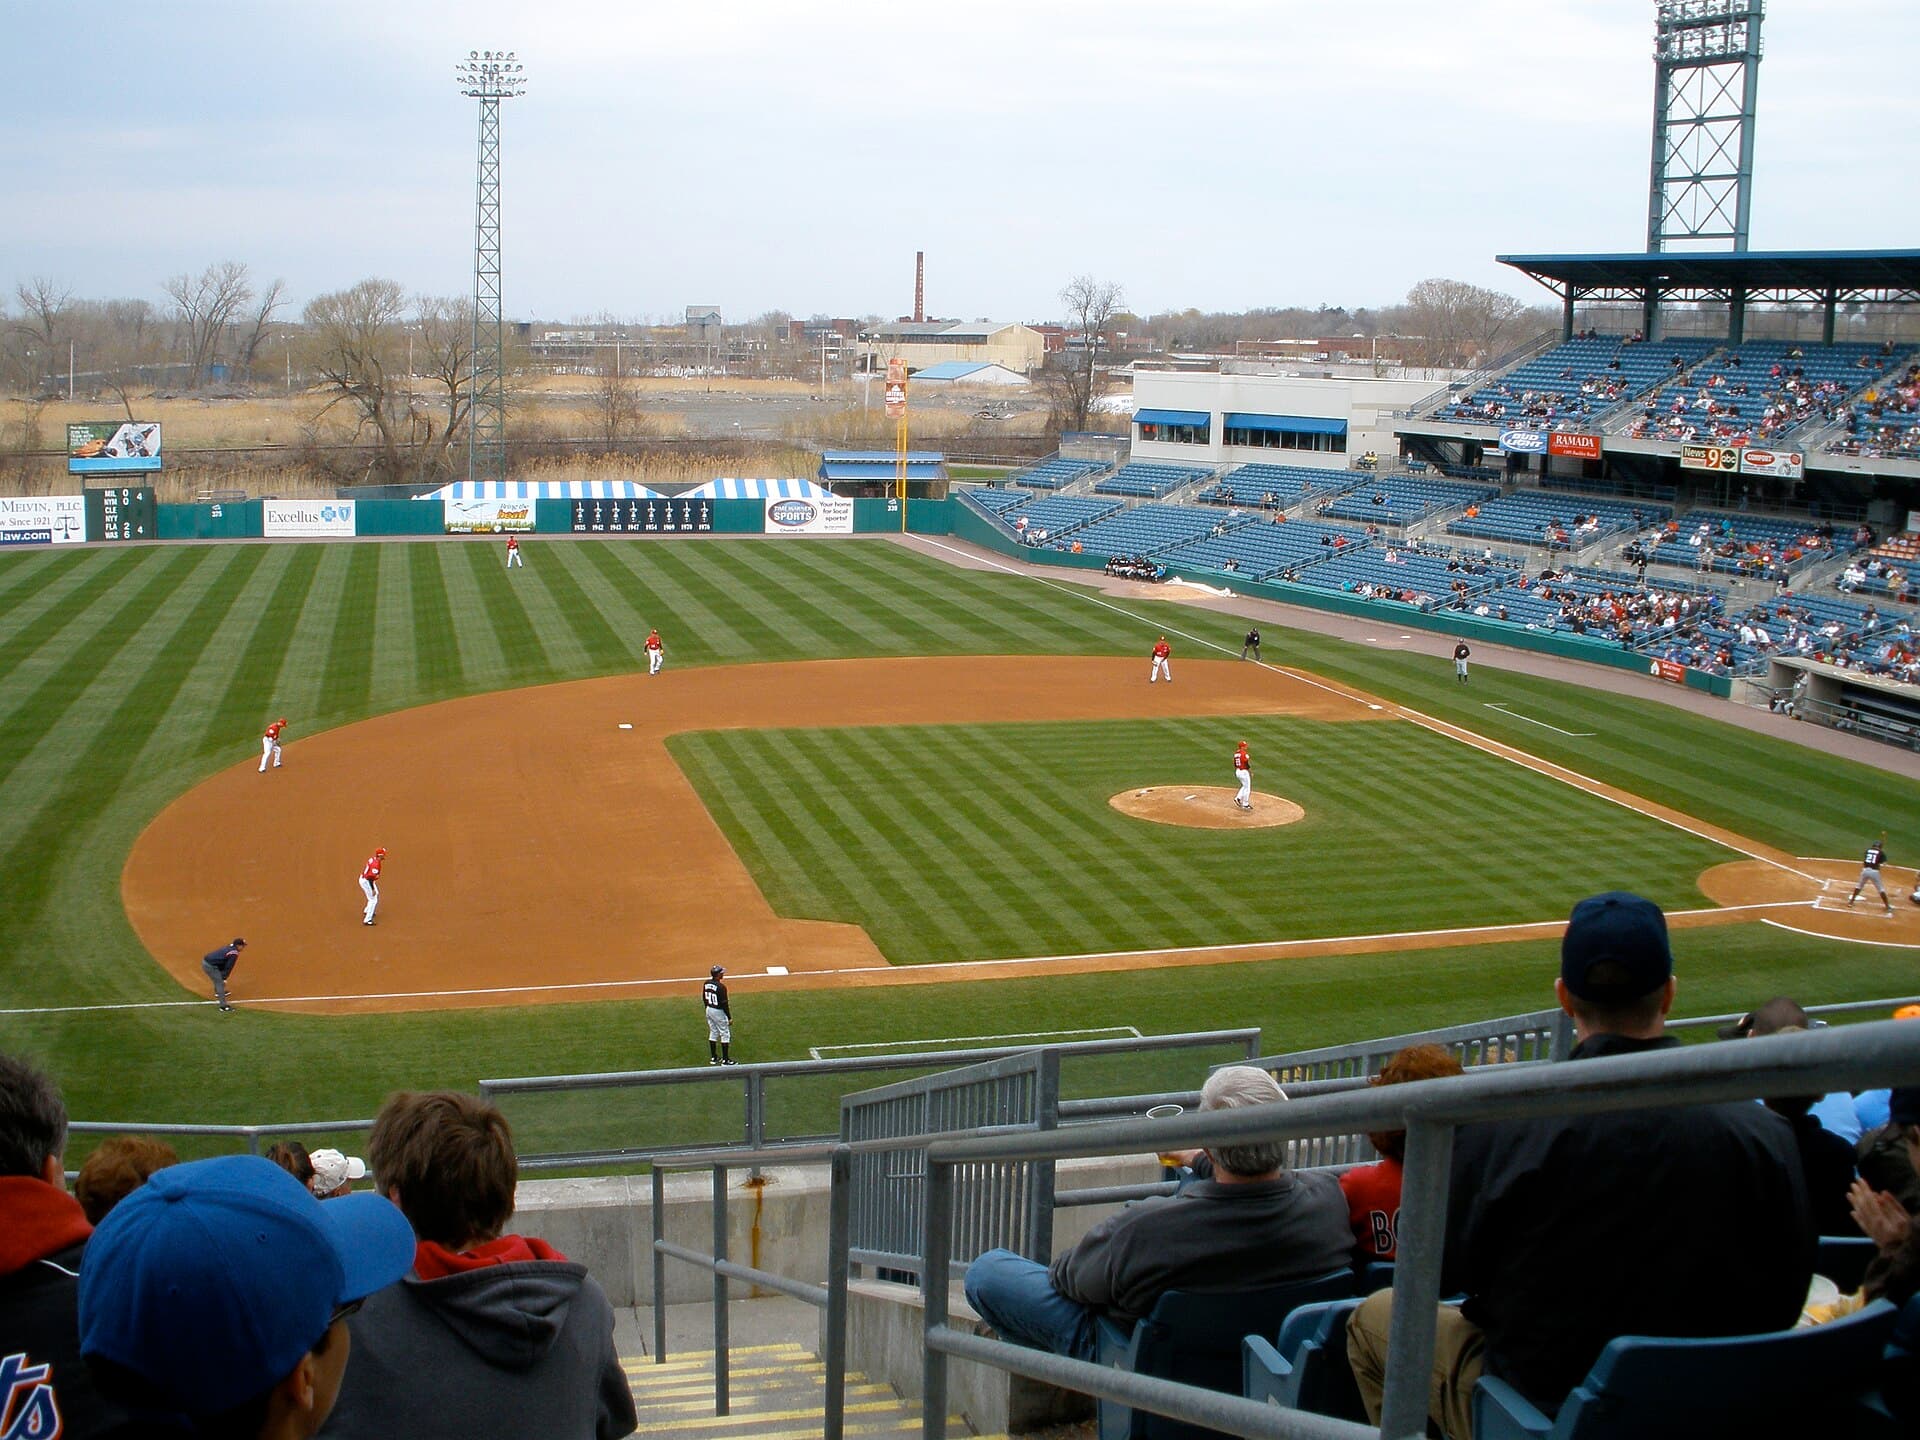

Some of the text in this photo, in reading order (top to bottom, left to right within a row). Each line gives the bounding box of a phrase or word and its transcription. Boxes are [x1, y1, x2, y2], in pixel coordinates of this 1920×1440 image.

[1511, 433, 1540, 441] BUD
[1556, 435, 1594, 448] RAMADA
[1507, 439, 1544, 448] LIGHT
[1684, 447, 1736, 467] News 9 abc
[104, 489, 129, 498] MIL 0
[136, 492, 143, 501] 4
[122, 497, 129, 506] 0
[835, 500, 852, 508] home
[268, 510, 319, 523] Excellus
[774, 513, 812, 521] SPORTS
[8, 517, 31, 527] Since
[33, 517, 50, 526] 1921
[123, 522, 130, 530] 2
[137, 525, 143, 534] 4
[123, 530, 131, 539] 6
[1865, 853, 1877, 864] 21
[704, 991, 718, 1006] 40
